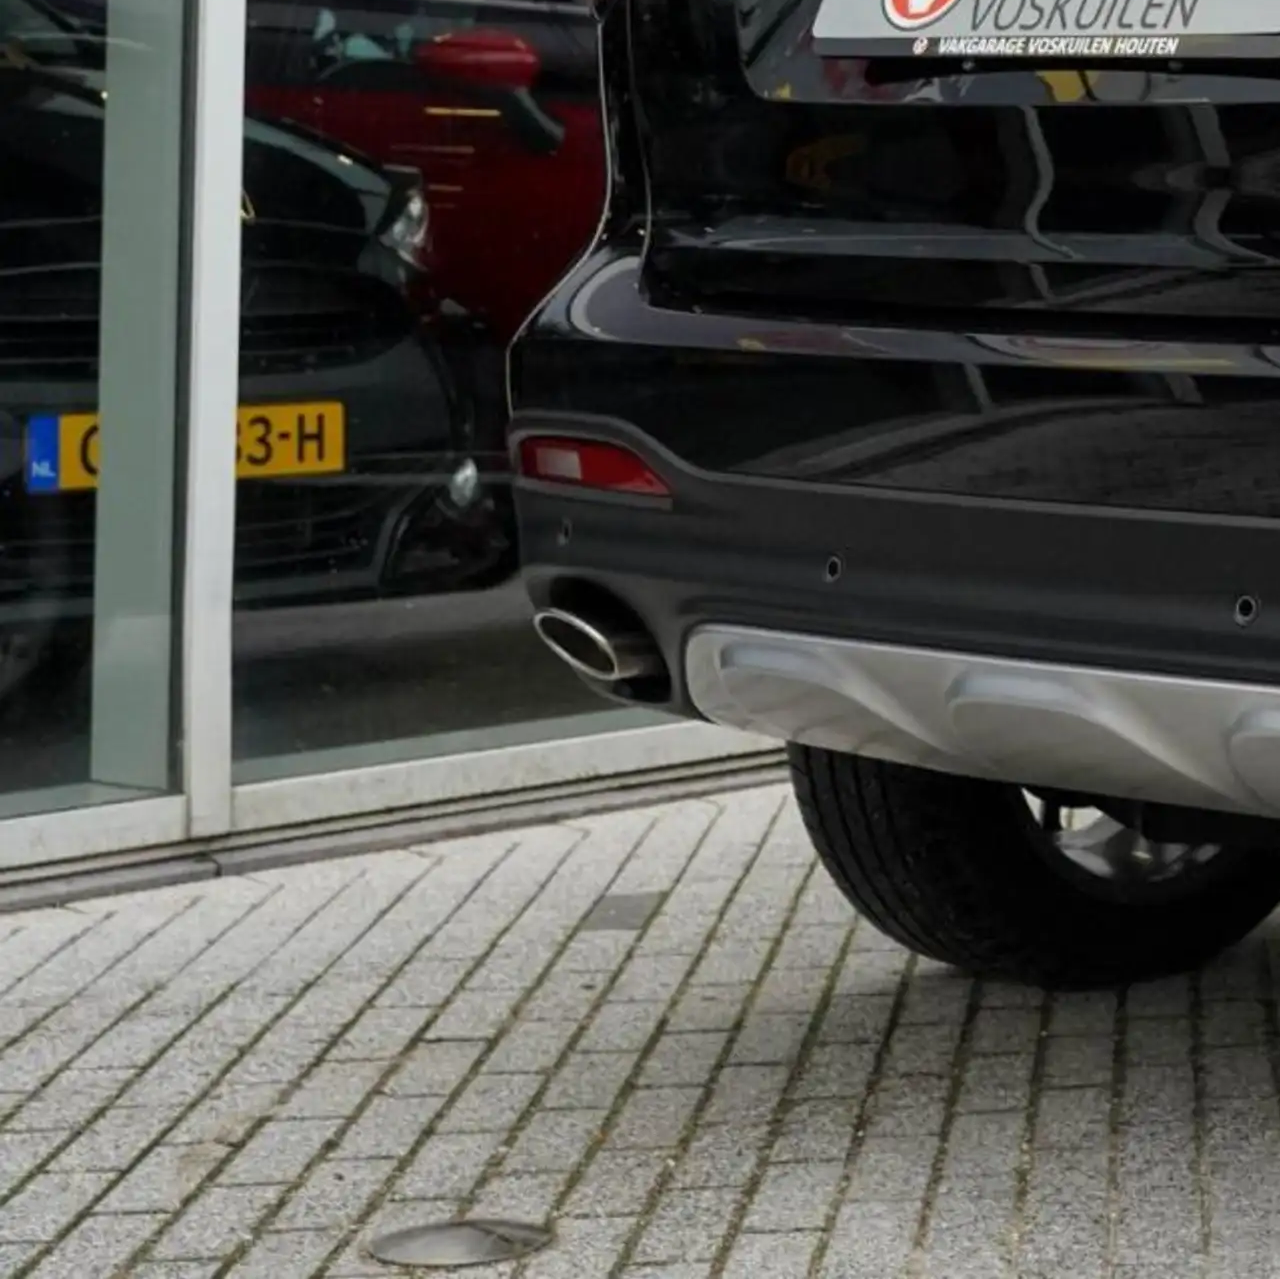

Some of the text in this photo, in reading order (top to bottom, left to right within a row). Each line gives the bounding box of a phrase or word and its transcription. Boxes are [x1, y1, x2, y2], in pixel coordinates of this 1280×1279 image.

[938, 36, 1179, 55] VAKGARAGE VOSKUILEN HOUTEN
